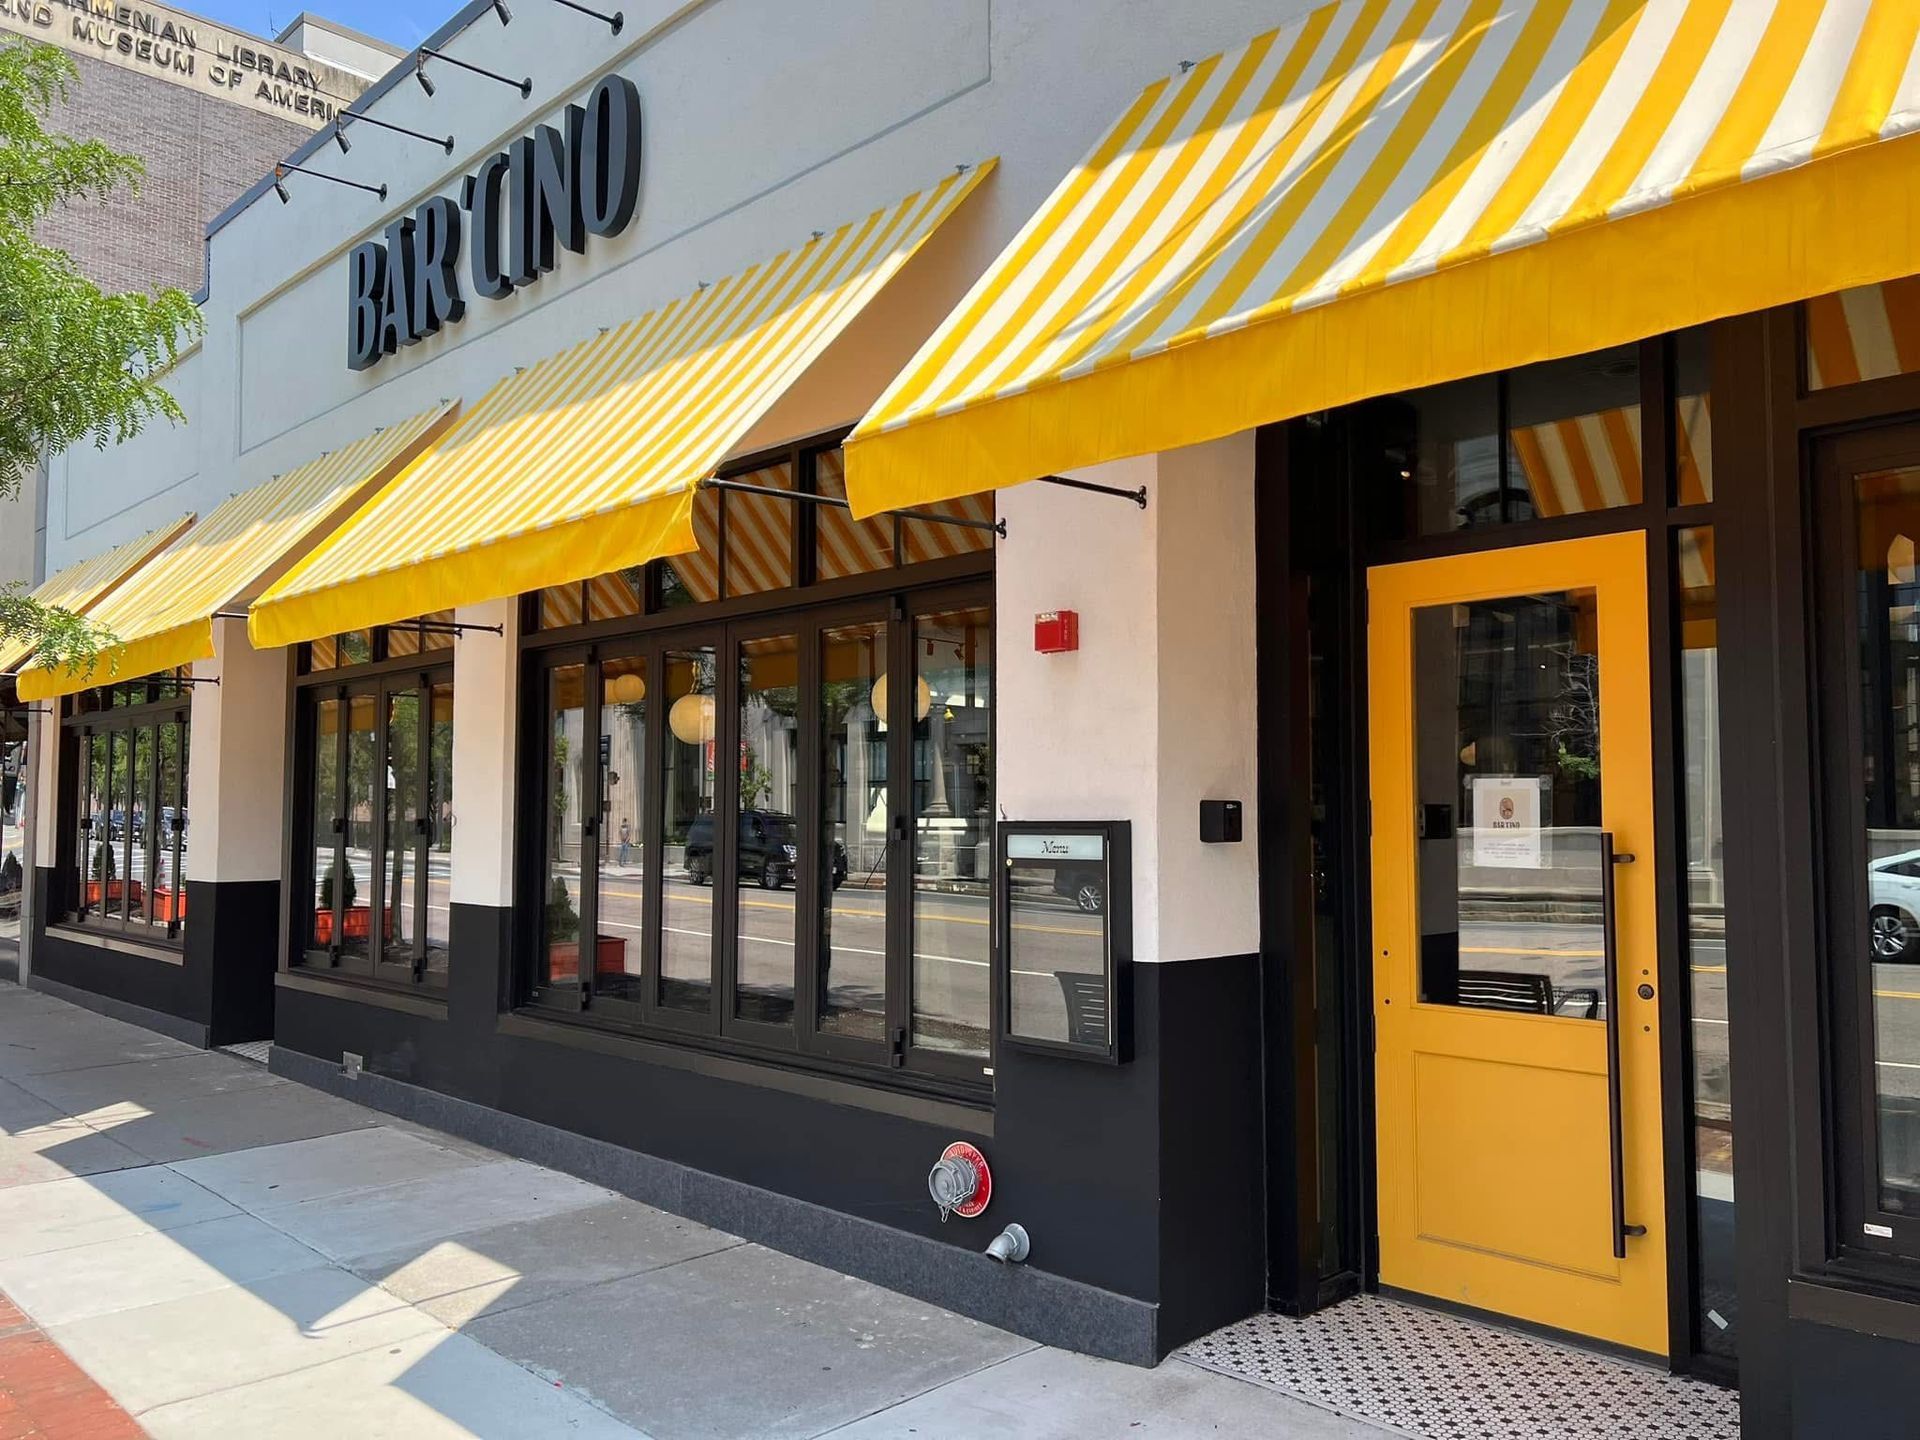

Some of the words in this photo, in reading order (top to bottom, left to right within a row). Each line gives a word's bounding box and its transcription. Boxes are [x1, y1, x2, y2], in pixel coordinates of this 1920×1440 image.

[61, 0, 196, 48] RMENIAN
[217, 39, 323, 91] LIBRARY
[73, 16, 195, 74] MUSEUM
[209, 64, 243, 87] OF
[255, 80, 338, 120] AMERI
